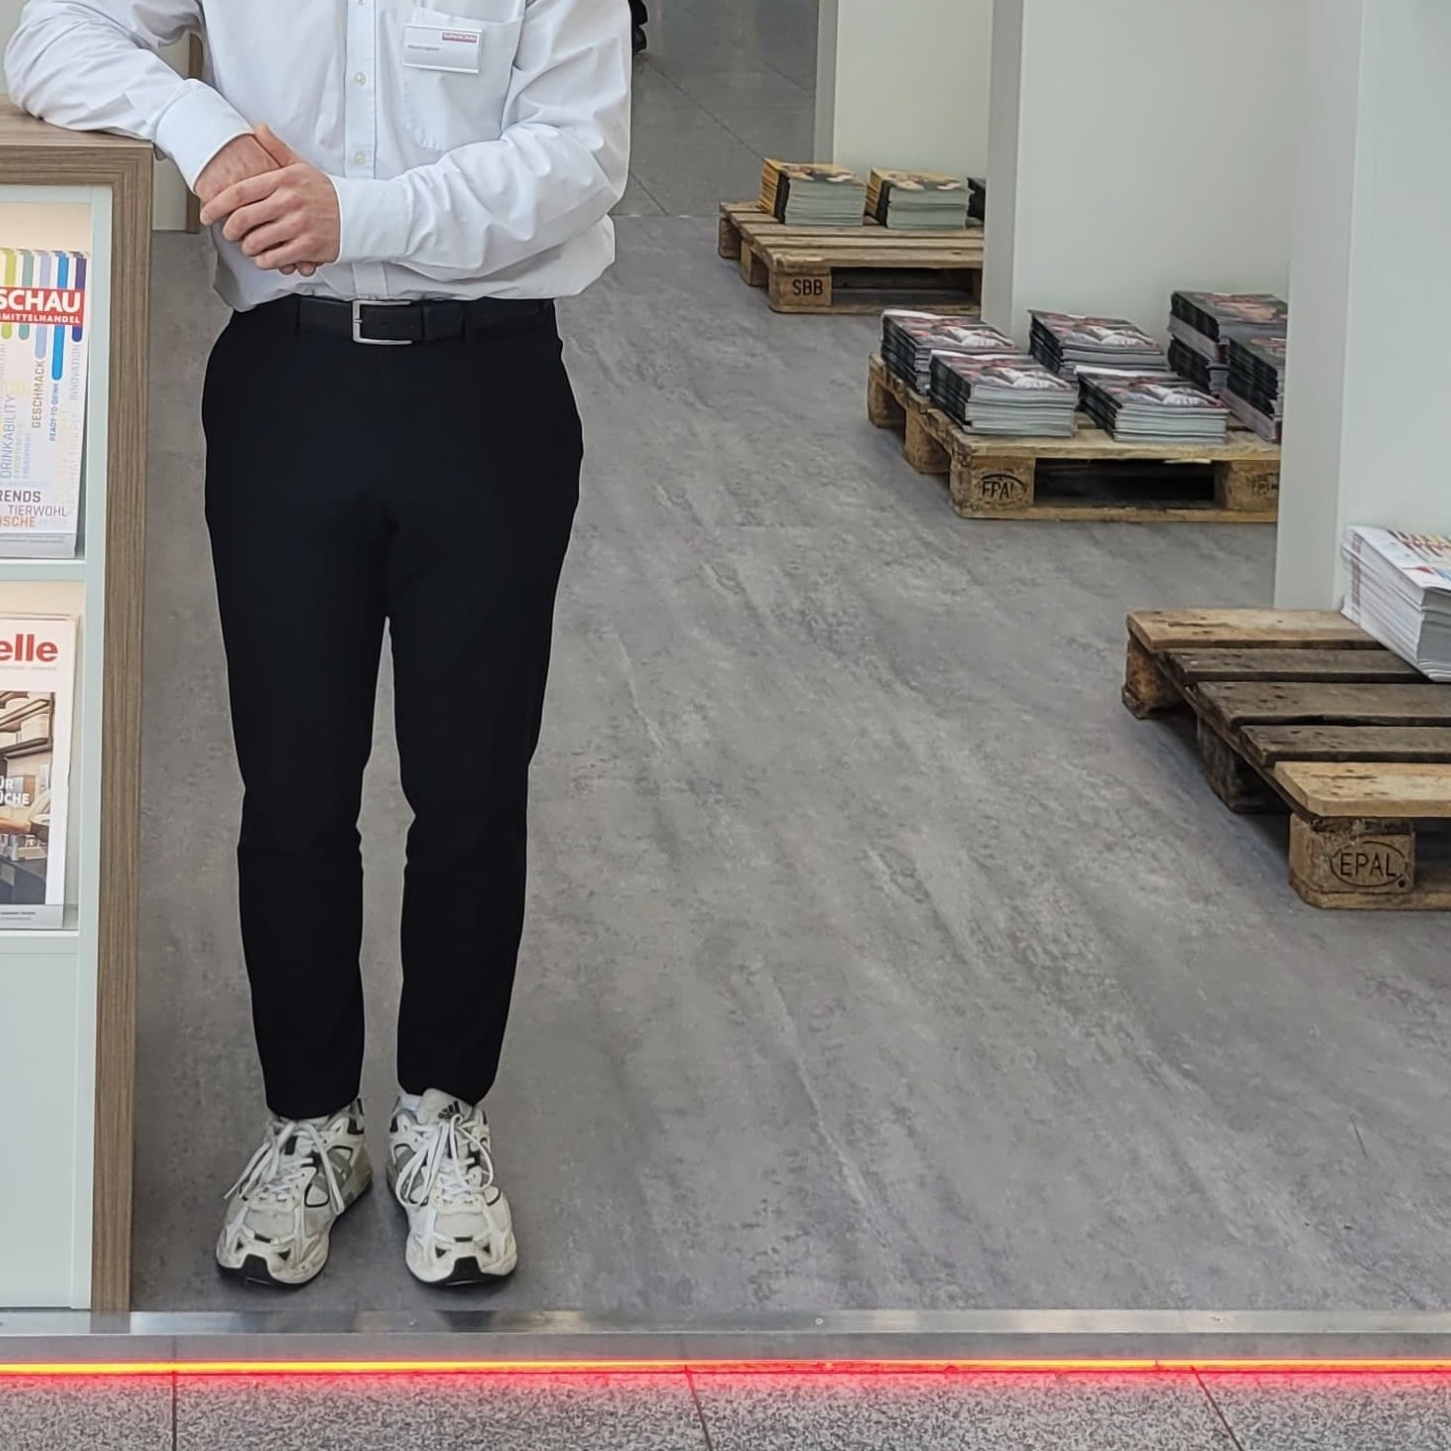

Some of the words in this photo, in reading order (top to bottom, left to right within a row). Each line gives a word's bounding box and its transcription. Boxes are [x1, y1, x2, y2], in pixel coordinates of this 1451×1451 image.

[792, 279, 823, 296] SBB
[32, 360, 46, 428] GESCHMACK
[0, 395, 18, 478] DRINKABILITY
[8, 504, 67, 517] TIERWOHL
[1340, 852, 1396, 877] EPAL
